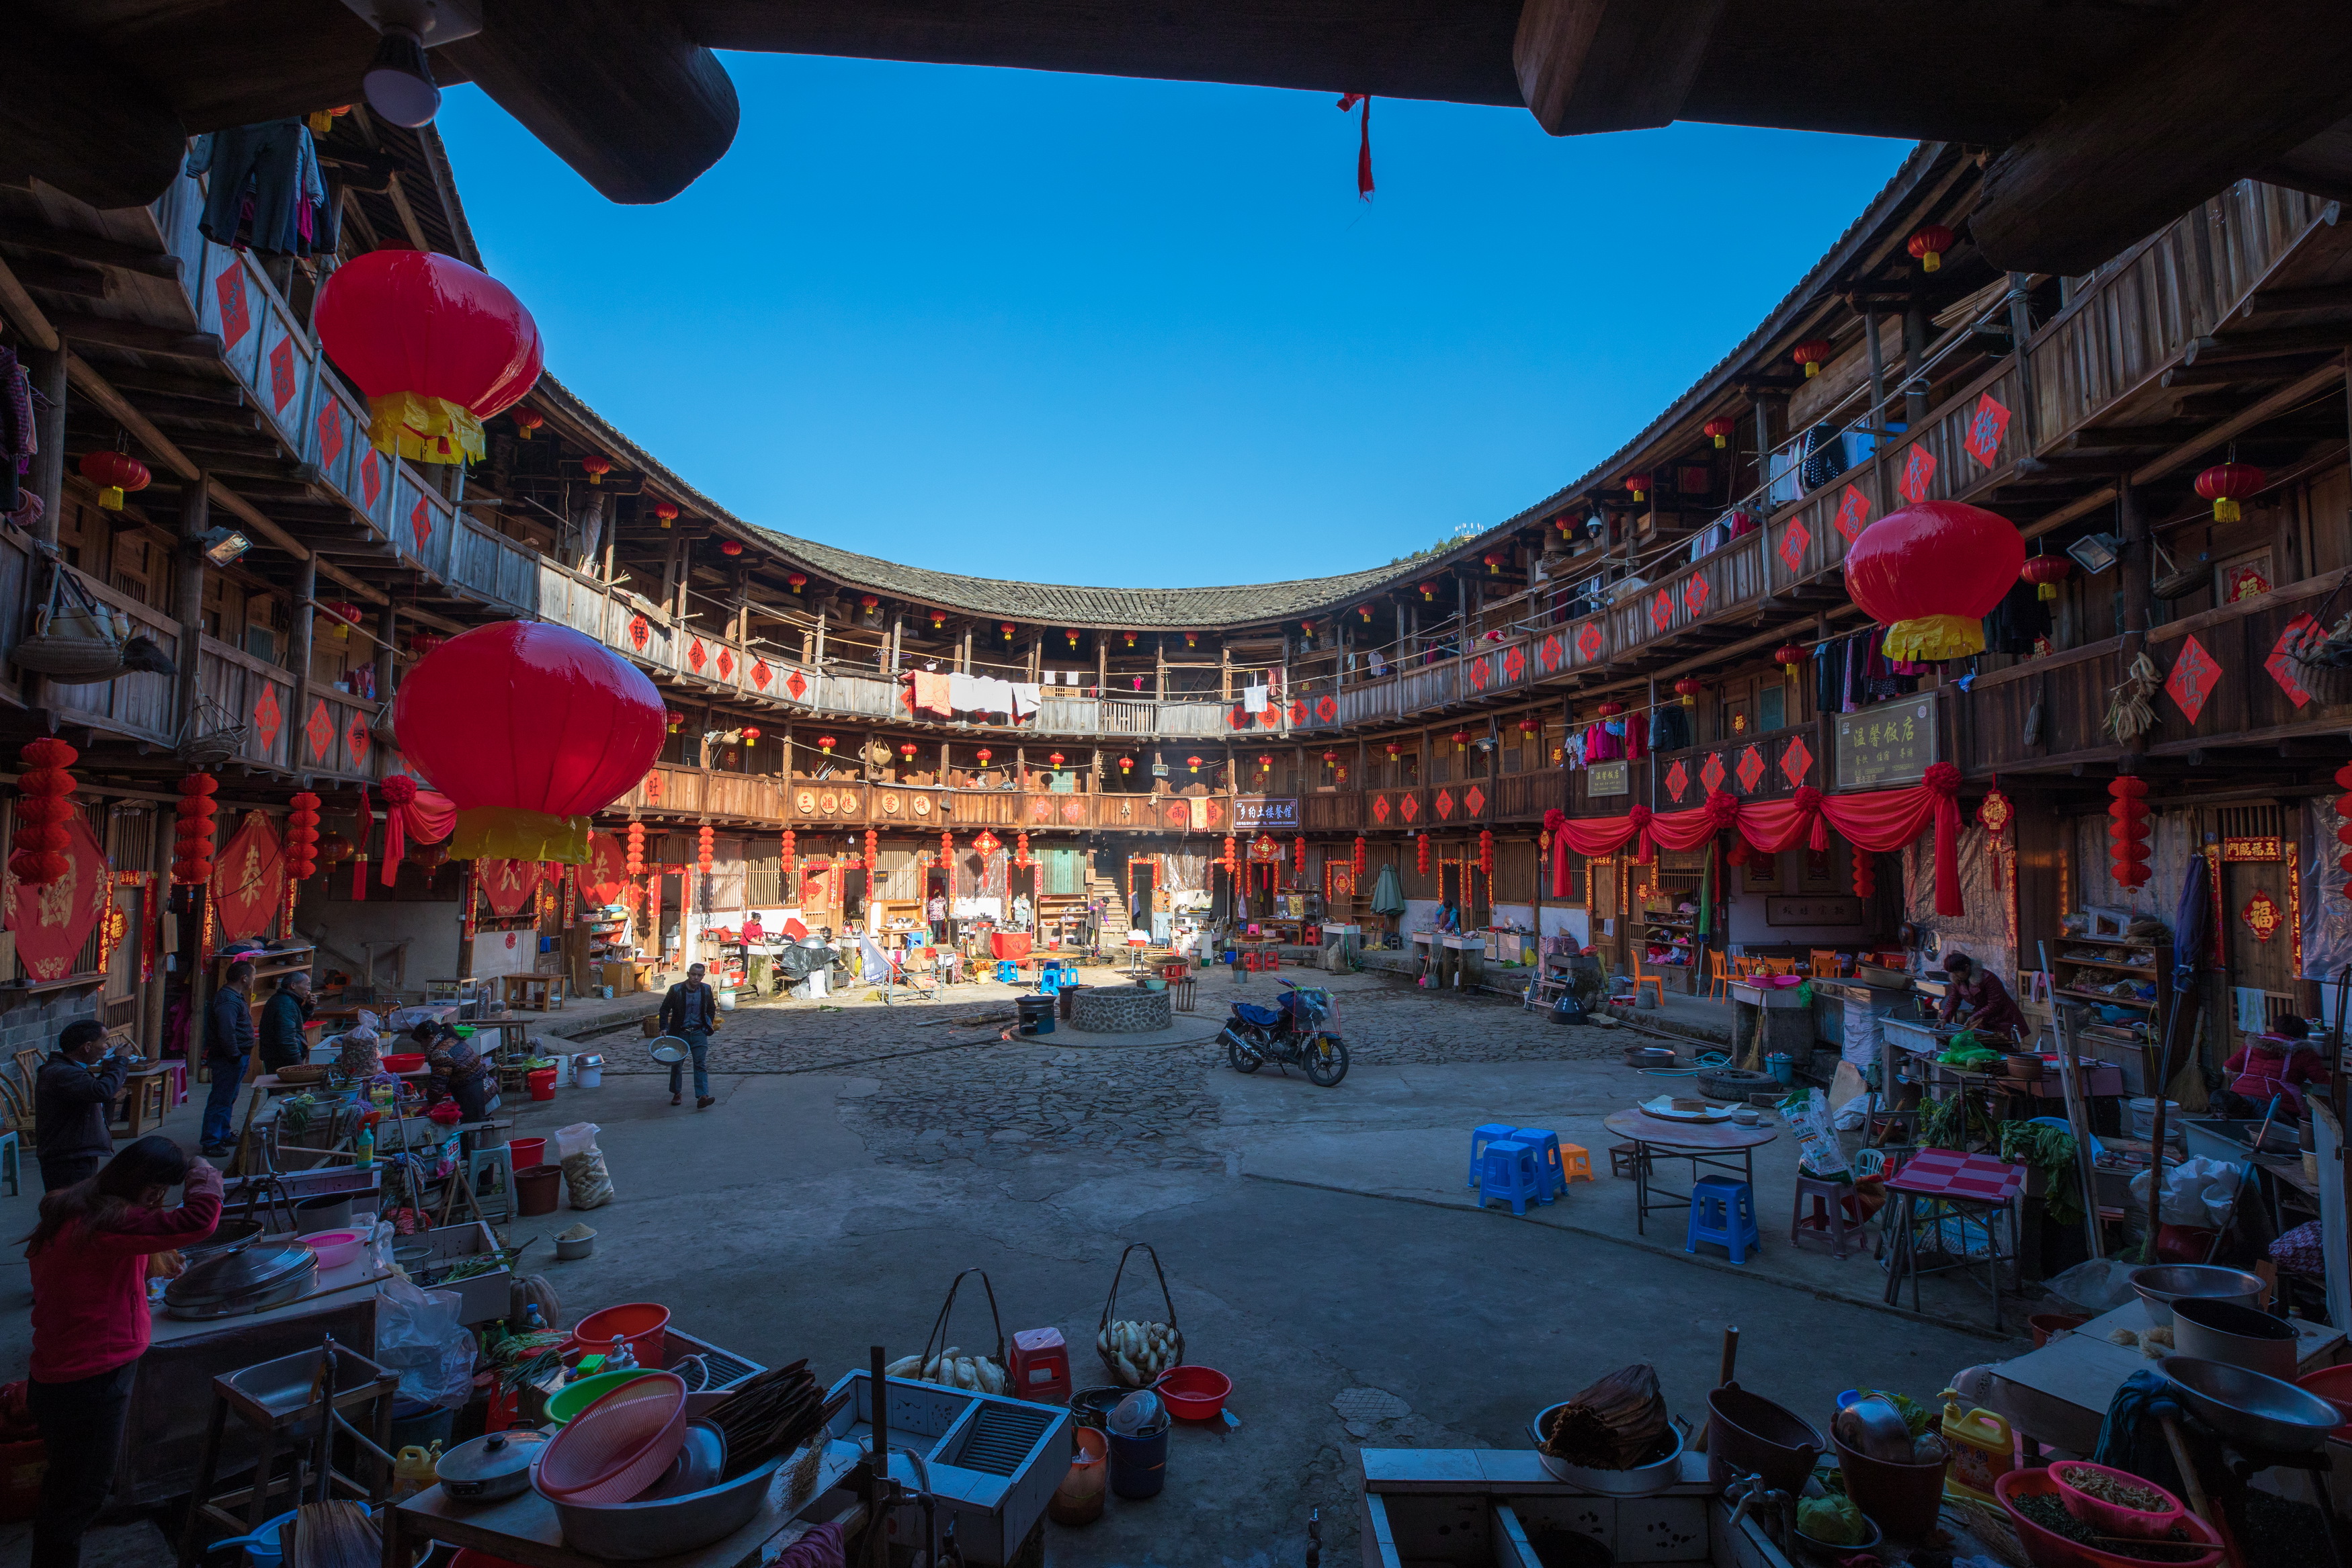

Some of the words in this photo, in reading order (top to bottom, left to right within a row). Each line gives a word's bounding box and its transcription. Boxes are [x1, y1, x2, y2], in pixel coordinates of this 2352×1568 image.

[1654, 600, 1669, 623] 如
[1689, 578, 1704, 611] 意
[2237, 576, 2261, 603] 福
[634, 621, 646, 645] 祥
[691, 645, 702, 668] 龍
[1509, 654, 1521, 674] 上
[1585, 626, 1598, 654] 花
[260, 697, 275, 733] 五
[313, 709, 331, 746] 谷
[648, 777, 659, 797] 旺
[1172, 806, 1185, 819] 雨
[1241, 804, 1292, 820] 乡约土楼餐馆
[1378, 799, 1386, 816] 大
[545, 896, 554, 910] 福
[2250, 900, 2274, 929] 福
[109, 913, 124, 939] 福
[447, 1141, 459, 1156] 立白
